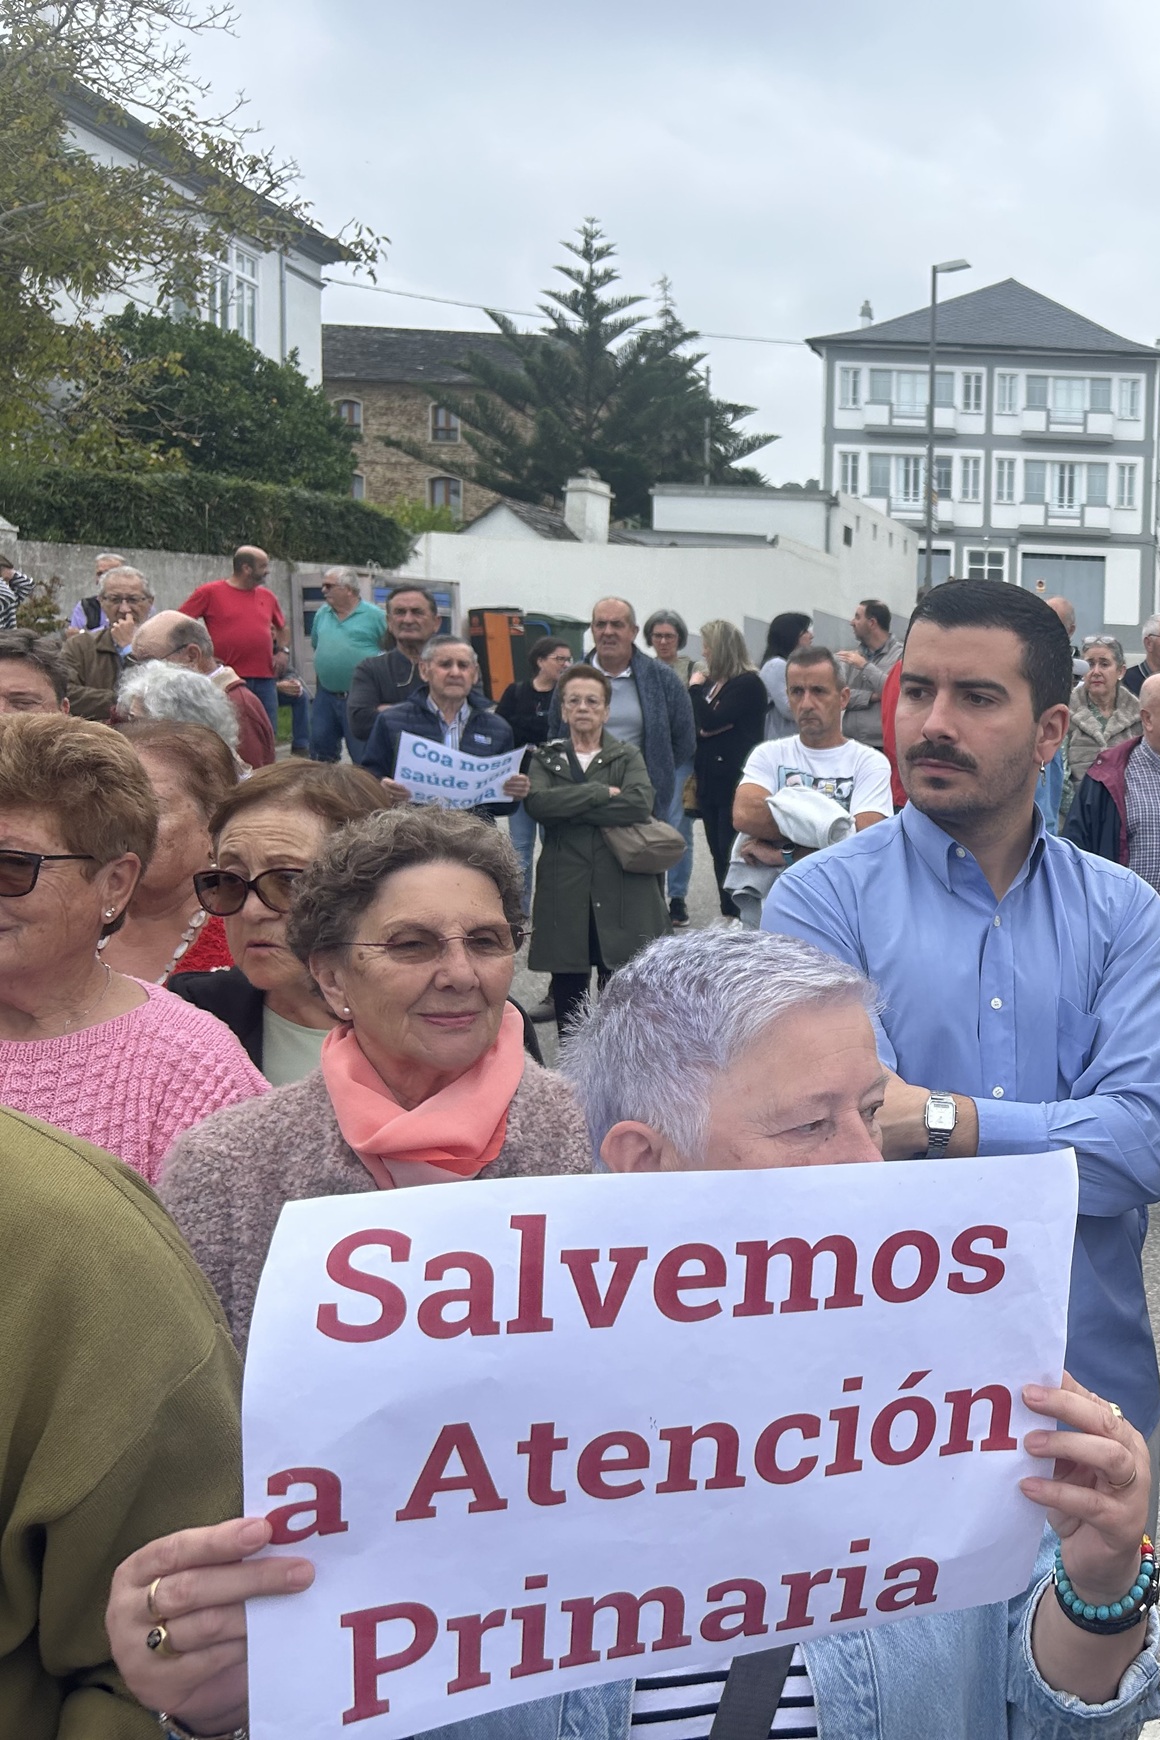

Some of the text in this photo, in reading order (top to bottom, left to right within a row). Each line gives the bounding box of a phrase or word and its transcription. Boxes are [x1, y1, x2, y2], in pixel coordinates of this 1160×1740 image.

[400, 766, 469, 790] saúde
[412, 742, 512, 772] Coa nosa
[316, 1214, 1008, 1342] Salvemos
[266, 1370, 1018, 1545] a Atención
[340, 1538, 938, 1726] Primaria
